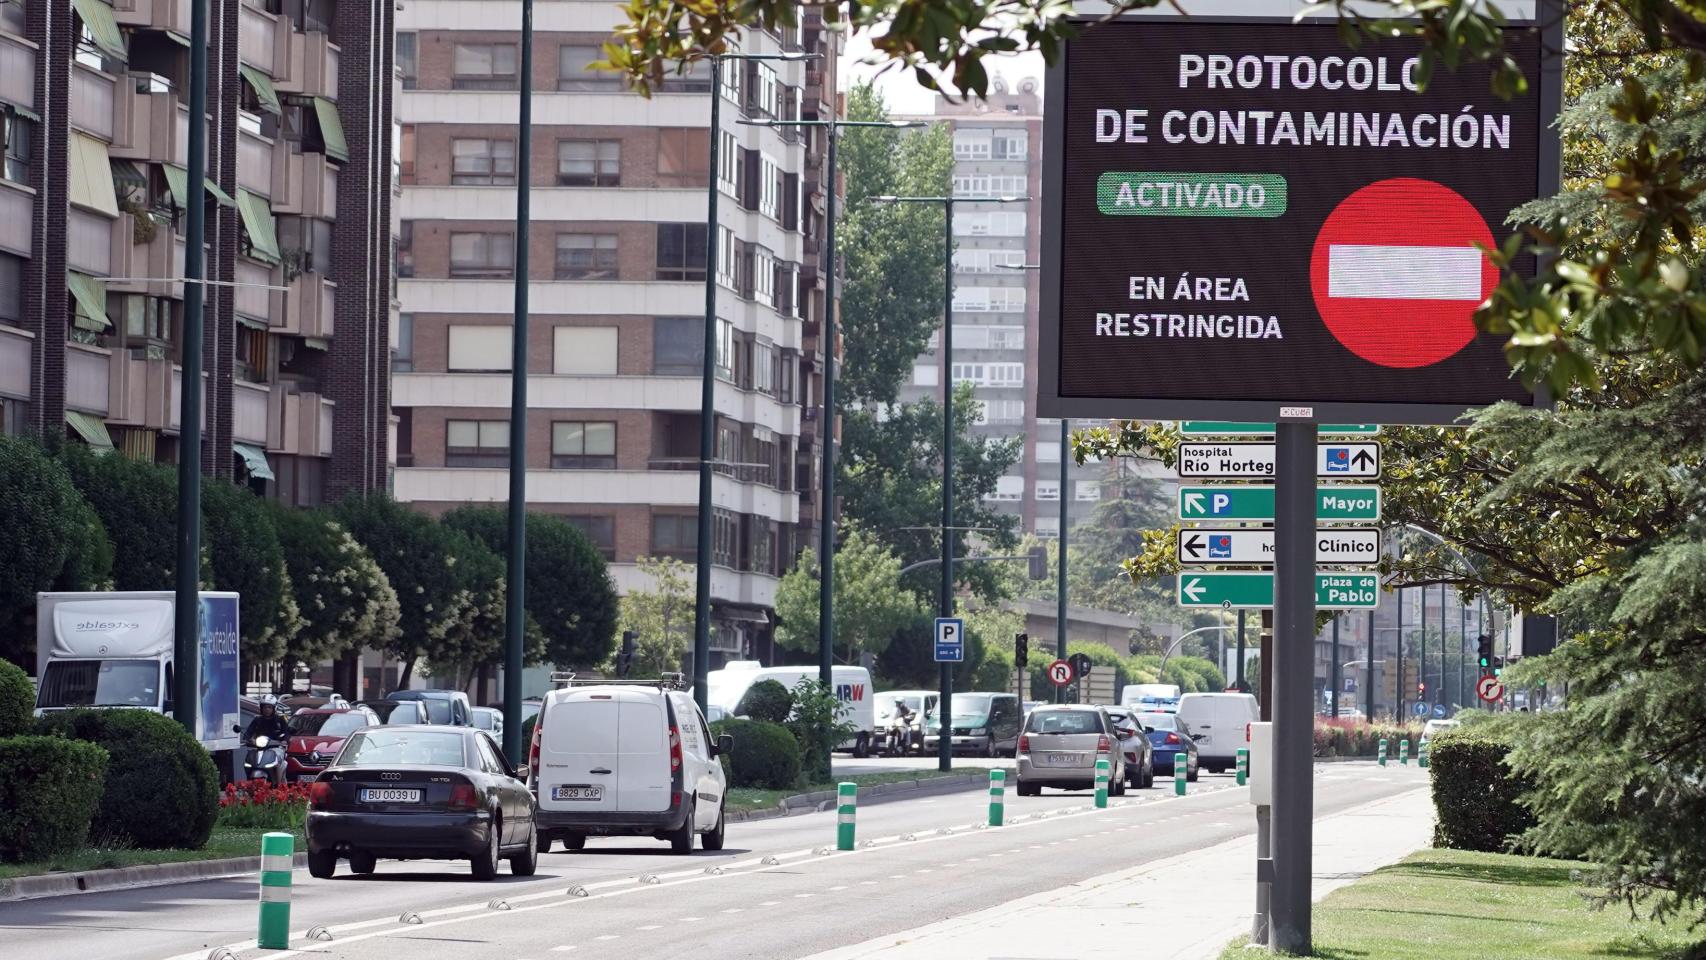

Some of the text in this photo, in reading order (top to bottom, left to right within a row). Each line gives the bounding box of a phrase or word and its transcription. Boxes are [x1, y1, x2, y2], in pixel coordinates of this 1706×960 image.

[1095, 104, 1511, 148] DE CONTAMINACIÓN
[1114, 182, 1266, 208] ACTIVADO
[1129, 271, 1250, 301] EN ÁREA
[1095, 312, 1284, 339] RESTRINGIDA
[1184, 447, 1233, 458] hospital
[1184, 459, 1274, 474] Río Horteg
[1213, 494, 1230, 514] P
[1322, 496, 1374, 512] Mayor
[1318, 539, 1375, 553] Clínico
[1321, 577, 1375, 589] plaza de
[1328, 589, 1375, 603] Pablo
[943, 625, 955, 640] P
[368, 790, 417, 801] BU 0039 U
[558, 788, 600, 798] 9829 GXP
